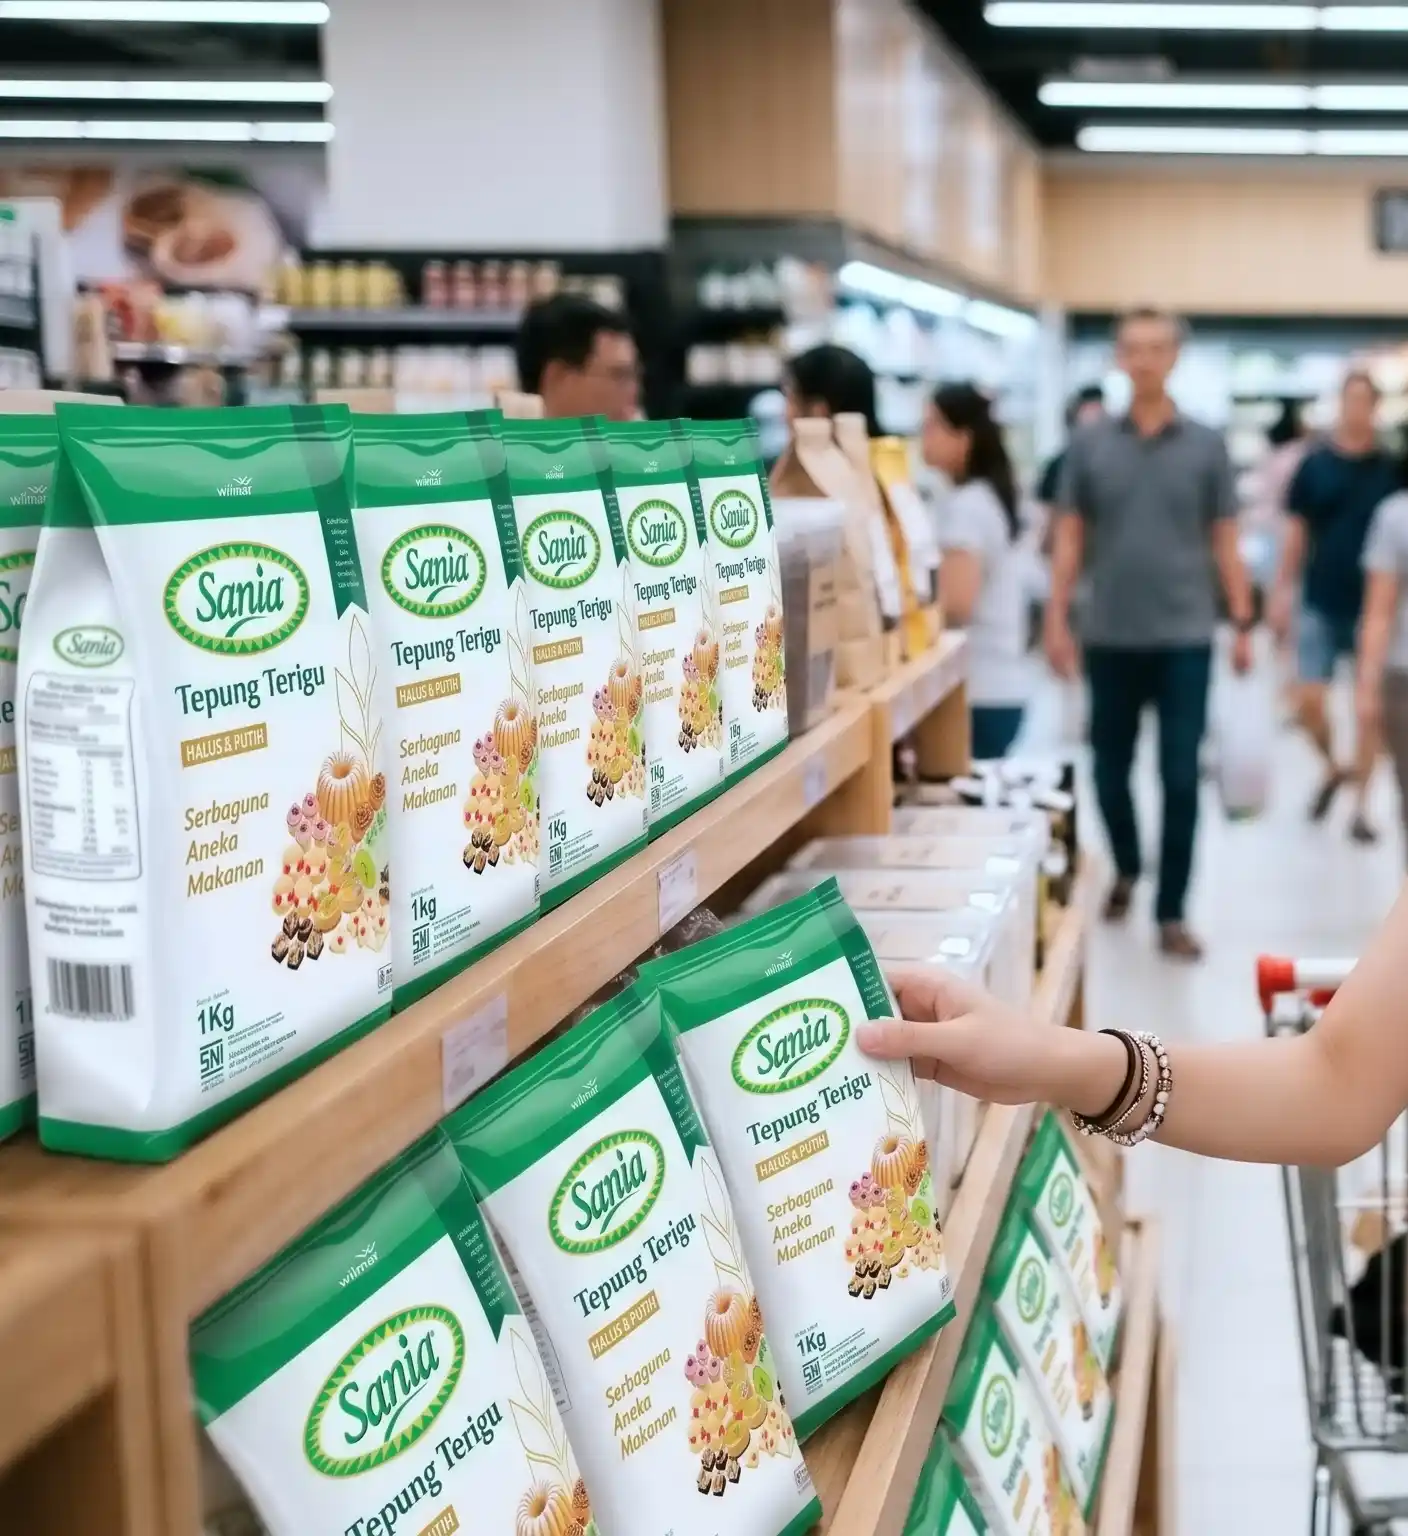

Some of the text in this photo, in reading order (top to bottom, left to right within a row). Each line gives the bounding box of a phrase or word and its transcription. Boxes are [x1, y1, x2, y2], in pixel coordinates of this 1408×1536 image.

[640, 513, 677, 546] Sania
[720, 501, 750, 530] Sania
[404, 541, 469, 590] Sania
[538, 525, 587, 566] Sania
[196, 563, 285, 624] Sania
[634, 574, 697, 605] Tepung Terigu
[529, 606, 577, 633] Tepung
[577, 597, 612, 621] Terigu
[66, 633, 118, 657] Sania
[390, 626, 502, 670] Tepung Terigu
[174, 664, 326, 718] Tepung Terigu
[400, 686, 427, 704] HALUS
[435, 677, 459, 696] PUTIH
[185, 742, 224, 762] HALUS
[233, 728, 265, 750] PUTIH
[399, 727, 461, 759] Serbaguna
[401, 760, 439, 786] Aneka
[184, 792, 270, 832] Serbaguna
[402, 781, 457, 812] Makanan
[185, 830, 239, 866] Aneka
[548, 818, 567, 841] 1Kg
[187, 858, 264, 898] Makanan
[197, 1002, 235, 1035] 1Kg
[200, 1043, 224, 1074] SNI
[756, 1012, 831, 1075] Sania
[746, 1099, 820, 1146] Tepung
[818, 1072, 872, 1111] Terigu
[759, 1155, 791, 1178] HALUS
[799, 1136, 827, 1158] PUTIH
[570, 1149, 647, 1232] Sania
[766, 1177, 834, 1222] Serbaguna
[772, 1212, 813, 1244] Aneka
[776, 1224, 836, 1266] Makanan
[572, 1255, 648, 1318] Tepung
[642, 1212, 697, 1264] Terigu
[591, 1321, 624, 1354] HALUS
[629, 1295, 658, 1325] PUTIH
[796, 1331, 828, 1357] 1Kg
[338, 1330, 440, 1445] Sania
[605, 1347, 672, 1408] Serbaguna
[613, 1395, 652, 1437] Aneka
[619, 1405, 678, 1461] Makanan
[344, 1401, 503, 1536] Tepung Terigu
